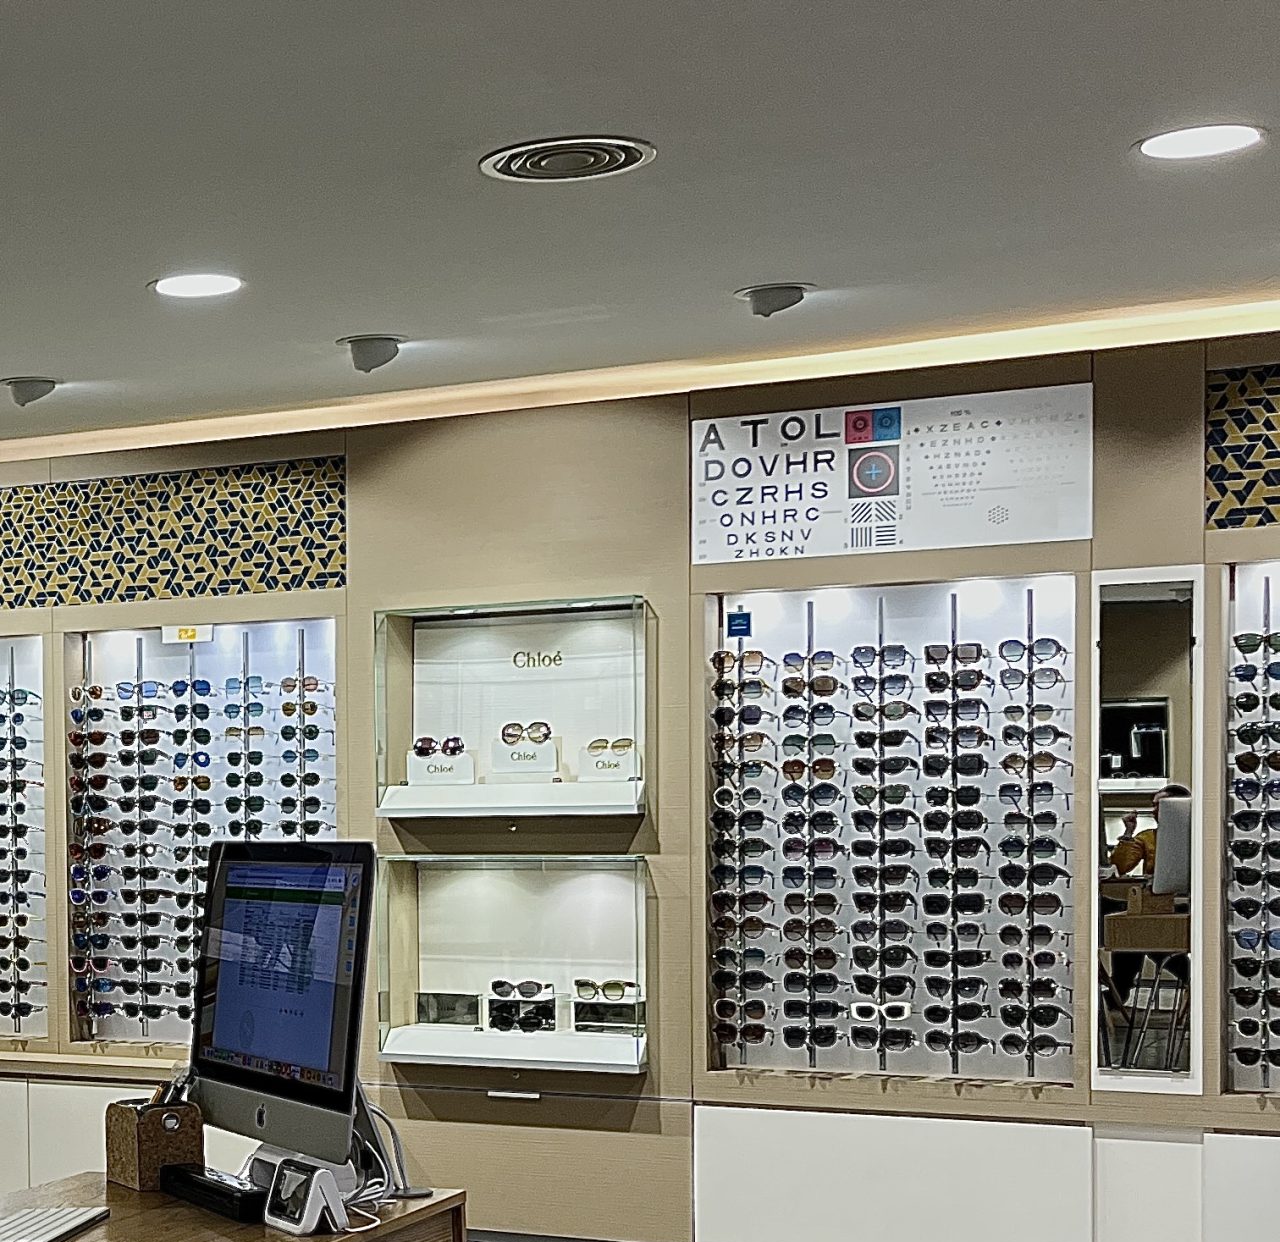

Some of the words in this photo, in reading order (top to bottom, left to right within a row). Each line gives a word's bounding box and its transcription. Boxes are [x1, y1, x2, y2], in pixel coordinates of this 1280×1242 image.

[704, 450, 835, 481] DOVHR
[711, 482, 829, 507] CZRHS
[720, 507, 820, 528] ONHRC
[727, 528, 812, 546] DKSNV
[512, 650, 563, 669] Chloé
[510, 750, 537, 762] Chloé
[595, 759, 621, 770] Chloé
[426, 763, 454, 774] Chloé
